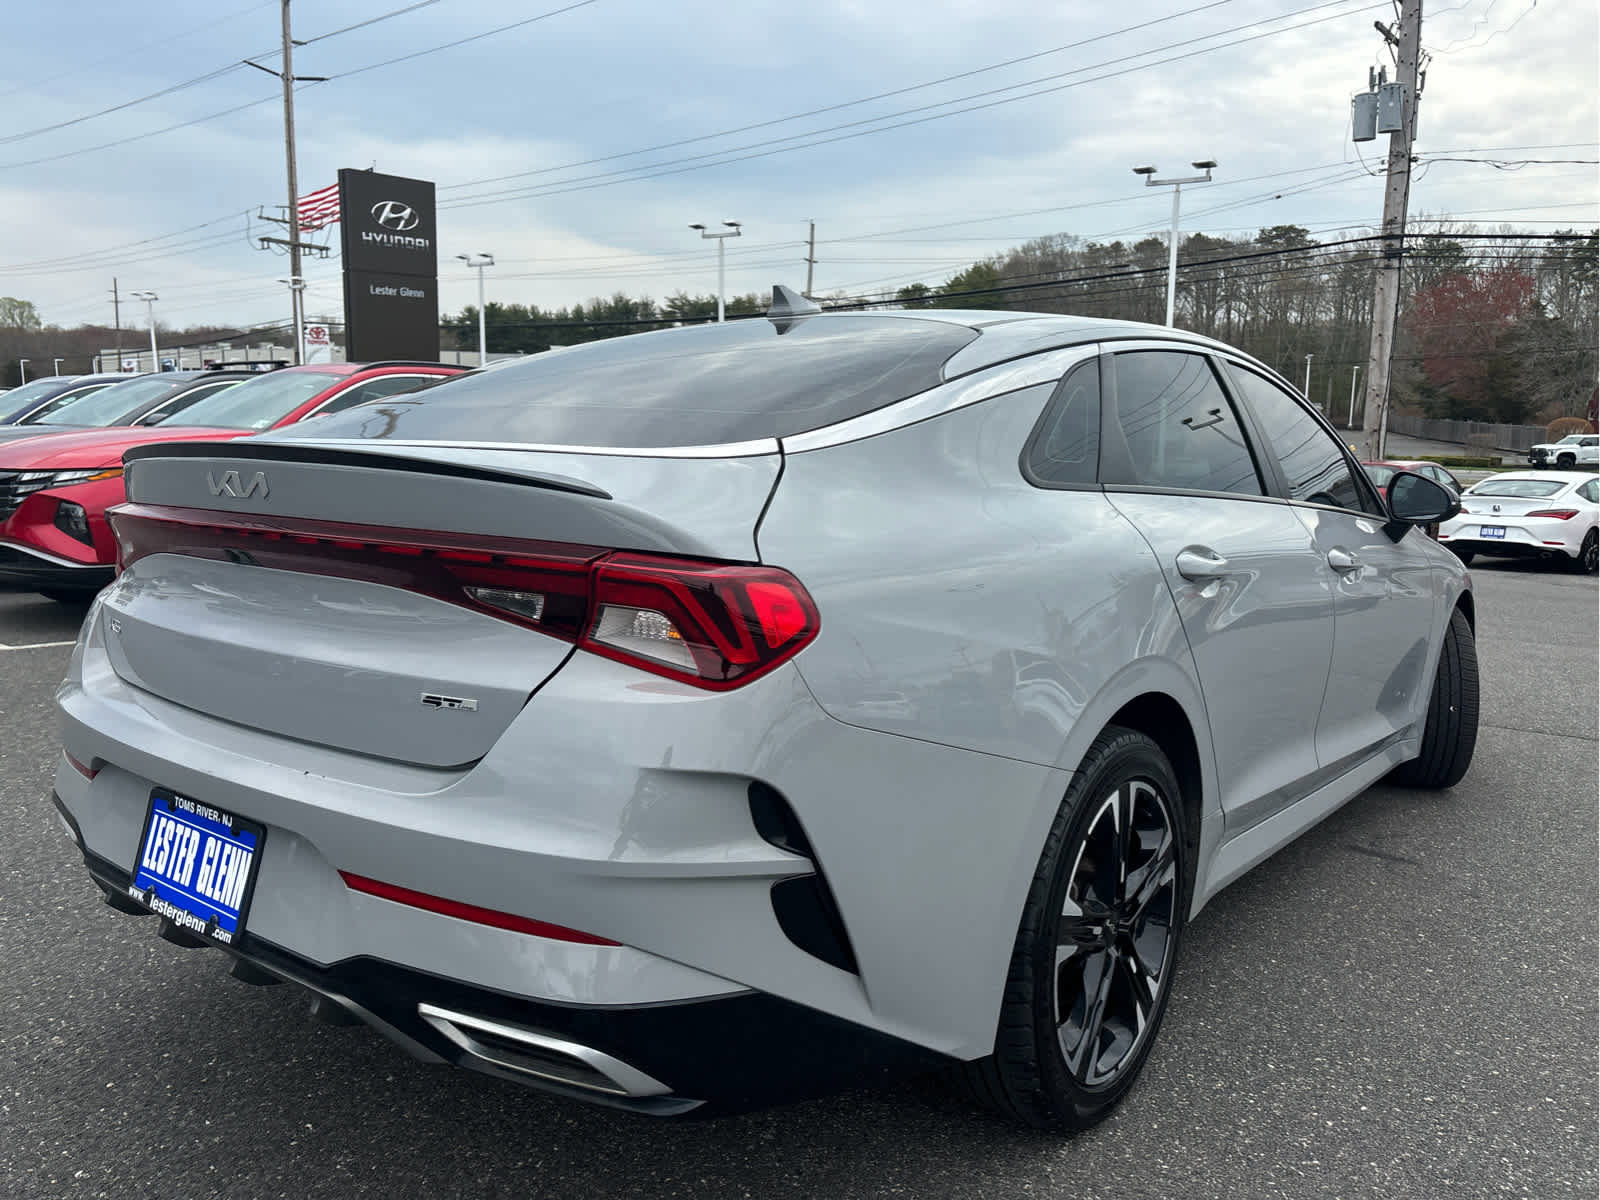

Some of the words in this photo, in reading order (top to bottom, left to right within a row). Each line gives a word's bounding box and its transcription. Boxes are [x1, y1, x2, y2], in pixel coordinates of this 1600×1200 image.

[362, 231, 430, 248] HYUNDAI
[369, 284, 398, 296] Lester
[399, 287, 425, 299] Glenn
[174, 796, 195, 814] TOMS
[196, 804, 221, 823] RIVER,
[222, 813, 233, 827] NJ
[142, 814, 200, 887] LESTER
[195, 836, 253, 911] GLENN
[149, 894, 206, 934] lesterglenn
